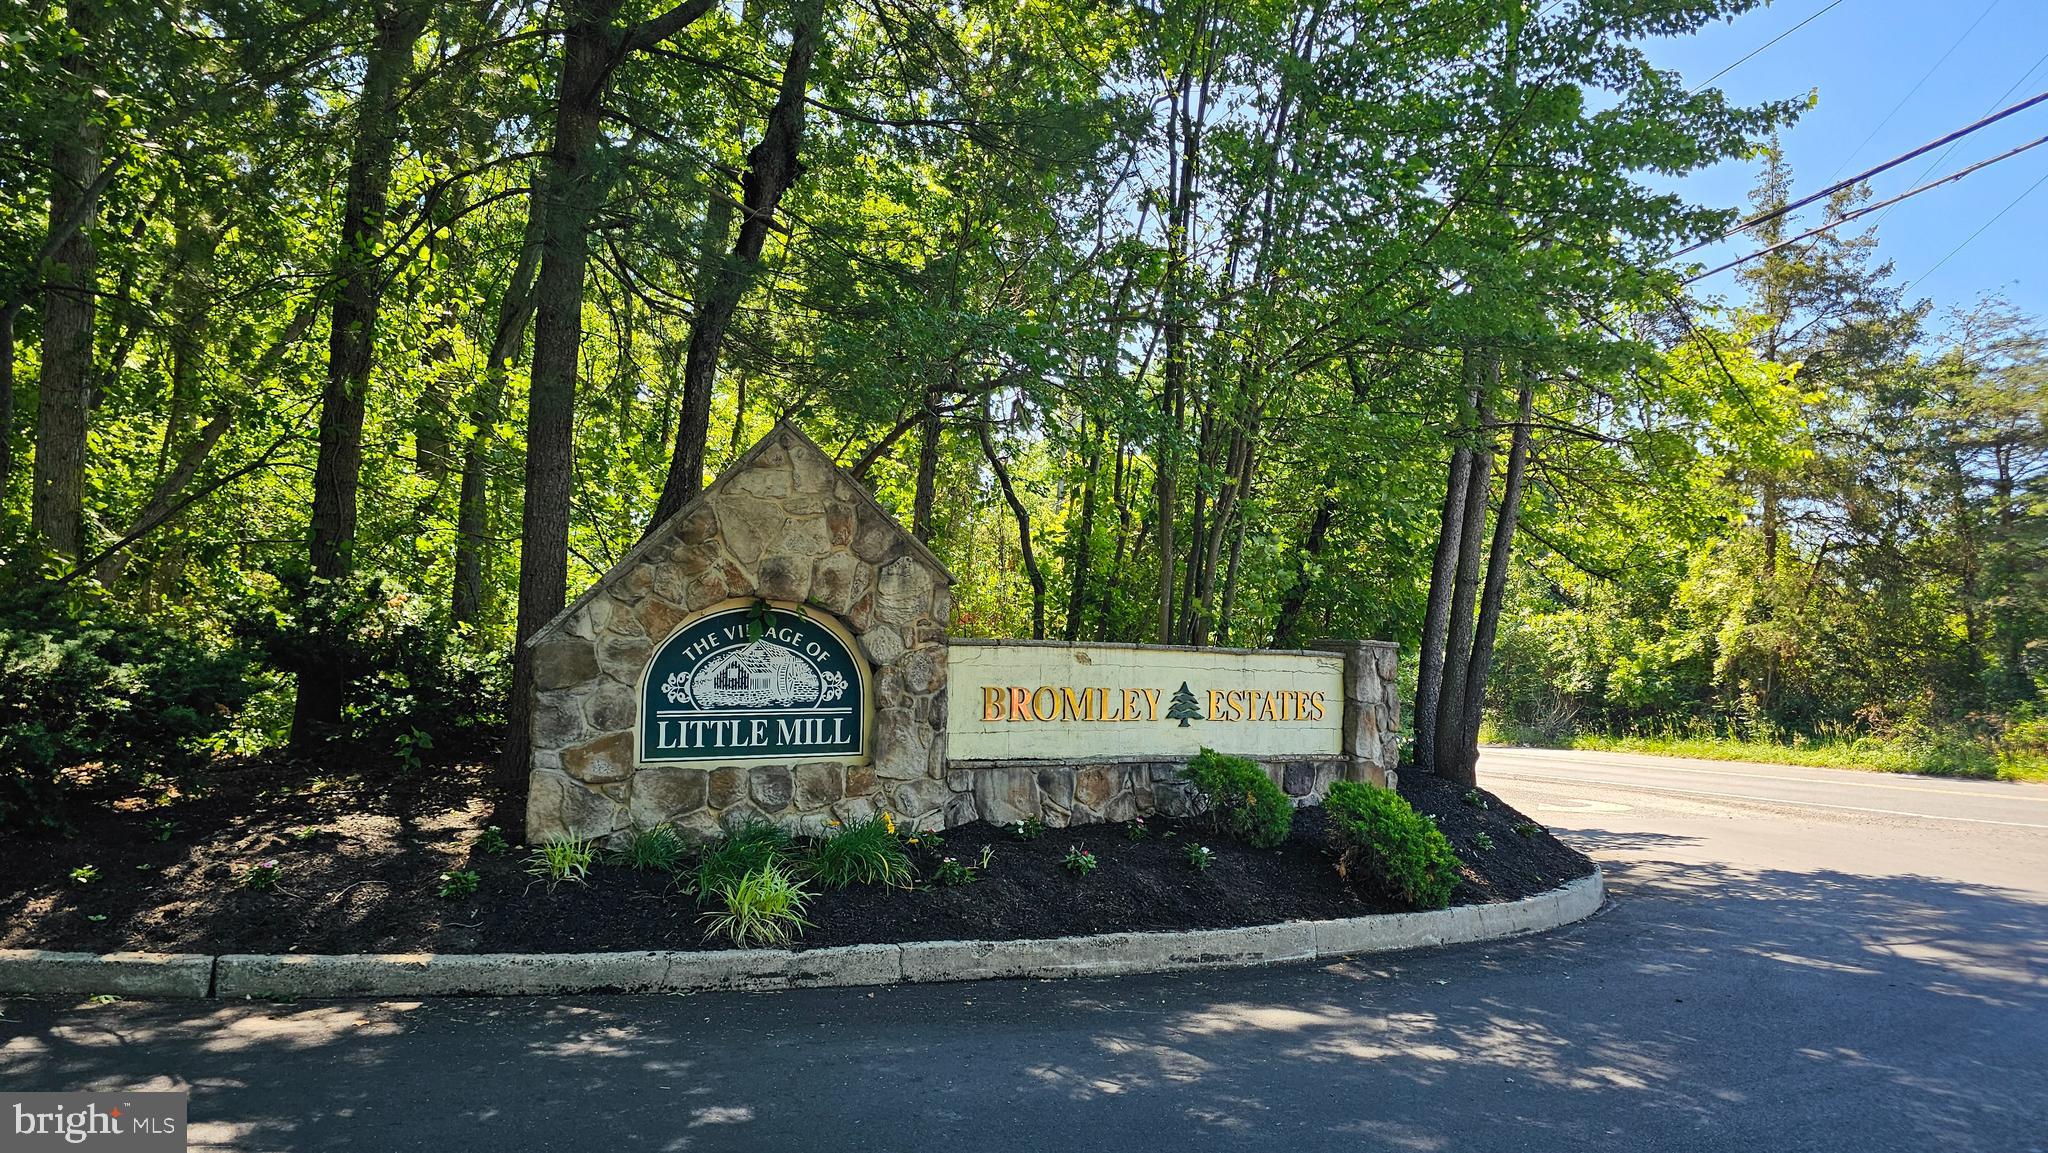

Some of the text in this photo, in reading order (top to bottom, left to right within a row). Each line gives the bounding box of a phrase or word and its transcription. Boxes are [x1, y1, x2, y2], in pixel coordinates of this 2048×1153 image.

[682, 624, 831, 663] THE VILAGE OF
[980, 686, 1327, 722] BROMLEY ESTATES
[656, 717, 852, 749] LITTLE MILL
